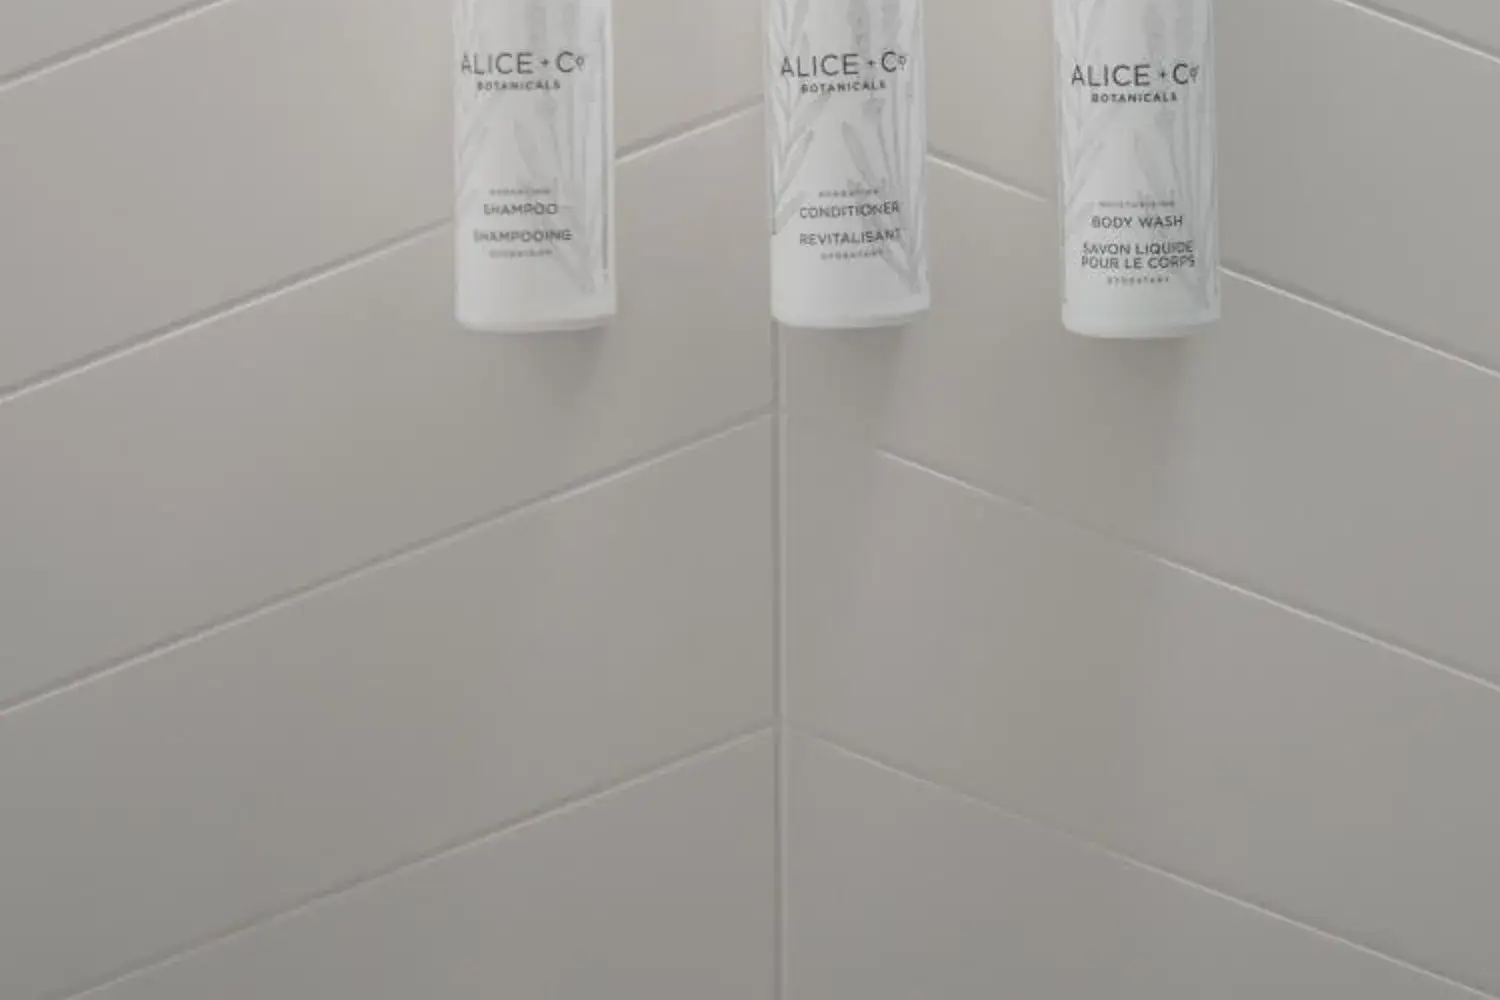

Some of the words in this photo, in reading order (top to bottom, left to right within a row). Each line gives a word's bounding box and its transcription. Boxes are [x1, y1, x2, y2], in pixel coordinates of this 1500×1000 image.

[461, 52, 534, 75] ALICE
[781, 53, 860, 77] ALICE
[1072, 64, 1151, 87] ALICE
[477, 79, 561, 91] BOTANICALS
[801, 79, 886, 94] BOTANICALS
[1091, 92, 1177, 103] BOTANICALS
[483, 202, 558, 216] SHAMPOO
[800, 200, 900, 219] CONDITIONER
[1091, 216, 1133, 229] BODY
[1138, 215, 1184, 229] WASH
[1083, 242, 1132, 255] SAVON
[1081, 256, 1119, 270] POUR
[1124, 257, 1144, 270] LE
[1147, 255, 1196, 270] CORPS
